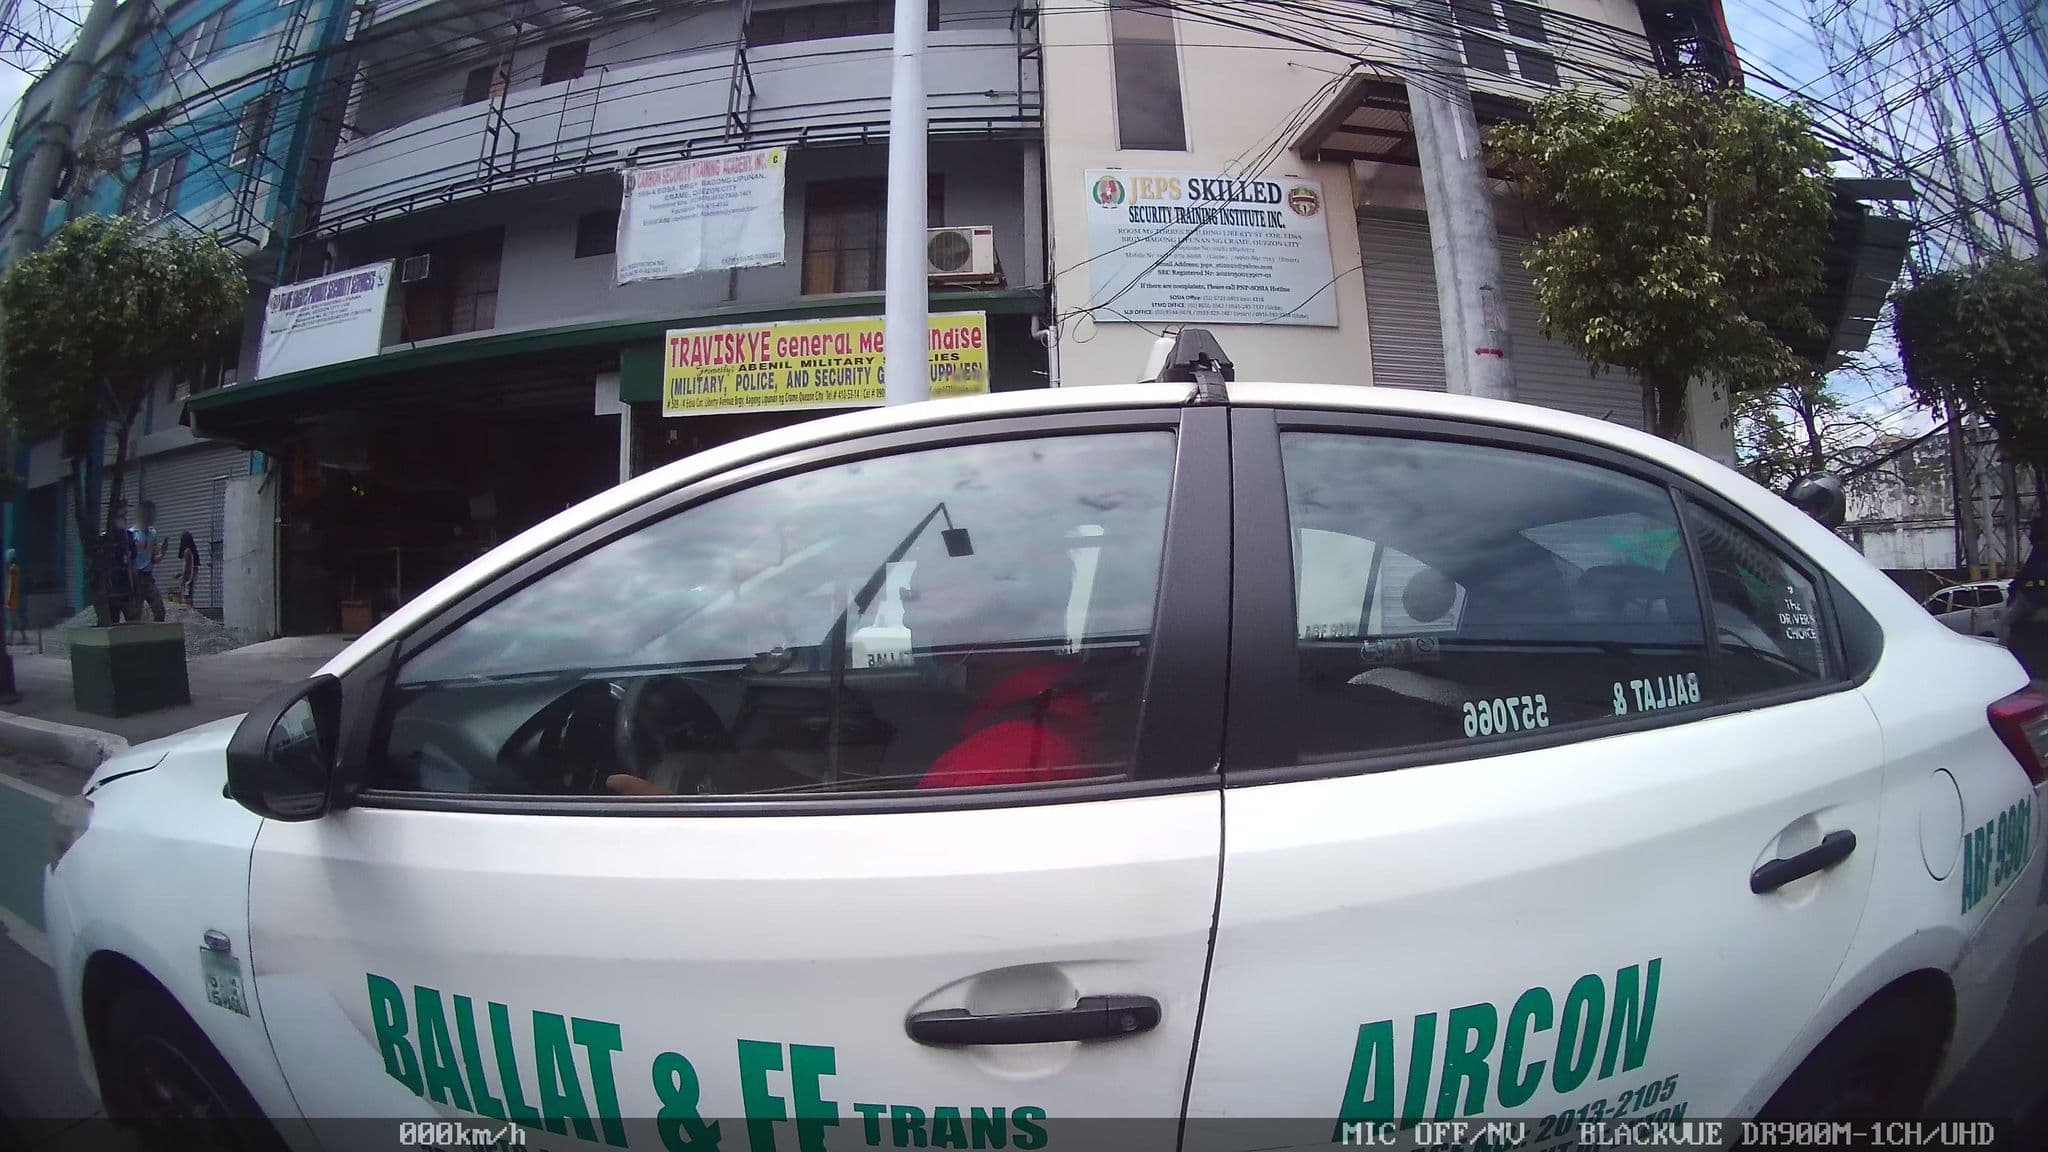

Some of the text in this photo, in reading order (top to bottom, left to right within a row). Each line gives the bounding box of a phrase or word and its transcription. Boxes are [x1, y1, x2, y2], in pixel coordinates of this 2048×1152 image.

[1128, 176, 1282, 204] JEPS SKILLED
[1128, 206, 1286, 229] SECURITY TRAINING INSTITUTE INC.
[670, 326, 982, 367] TRAVISKYE General Mendise
[738, 361, 793, 373] ABENIL
[800, 356, 876, 369] MILITARY
[670, 373, 728, 399] (MILITARY,
[735, 371, 778, 393] POLICE,
[786, 369, 809, 388] AND
[814, 366, 871, 387] SECURITY
[366, 972, 629, 1149] BALLAT
[652, 1051, 722, 1152] &
[853, 1103, 1049, 1150] TRANS
[1332, 957, 1663, 1144] AIRCON
